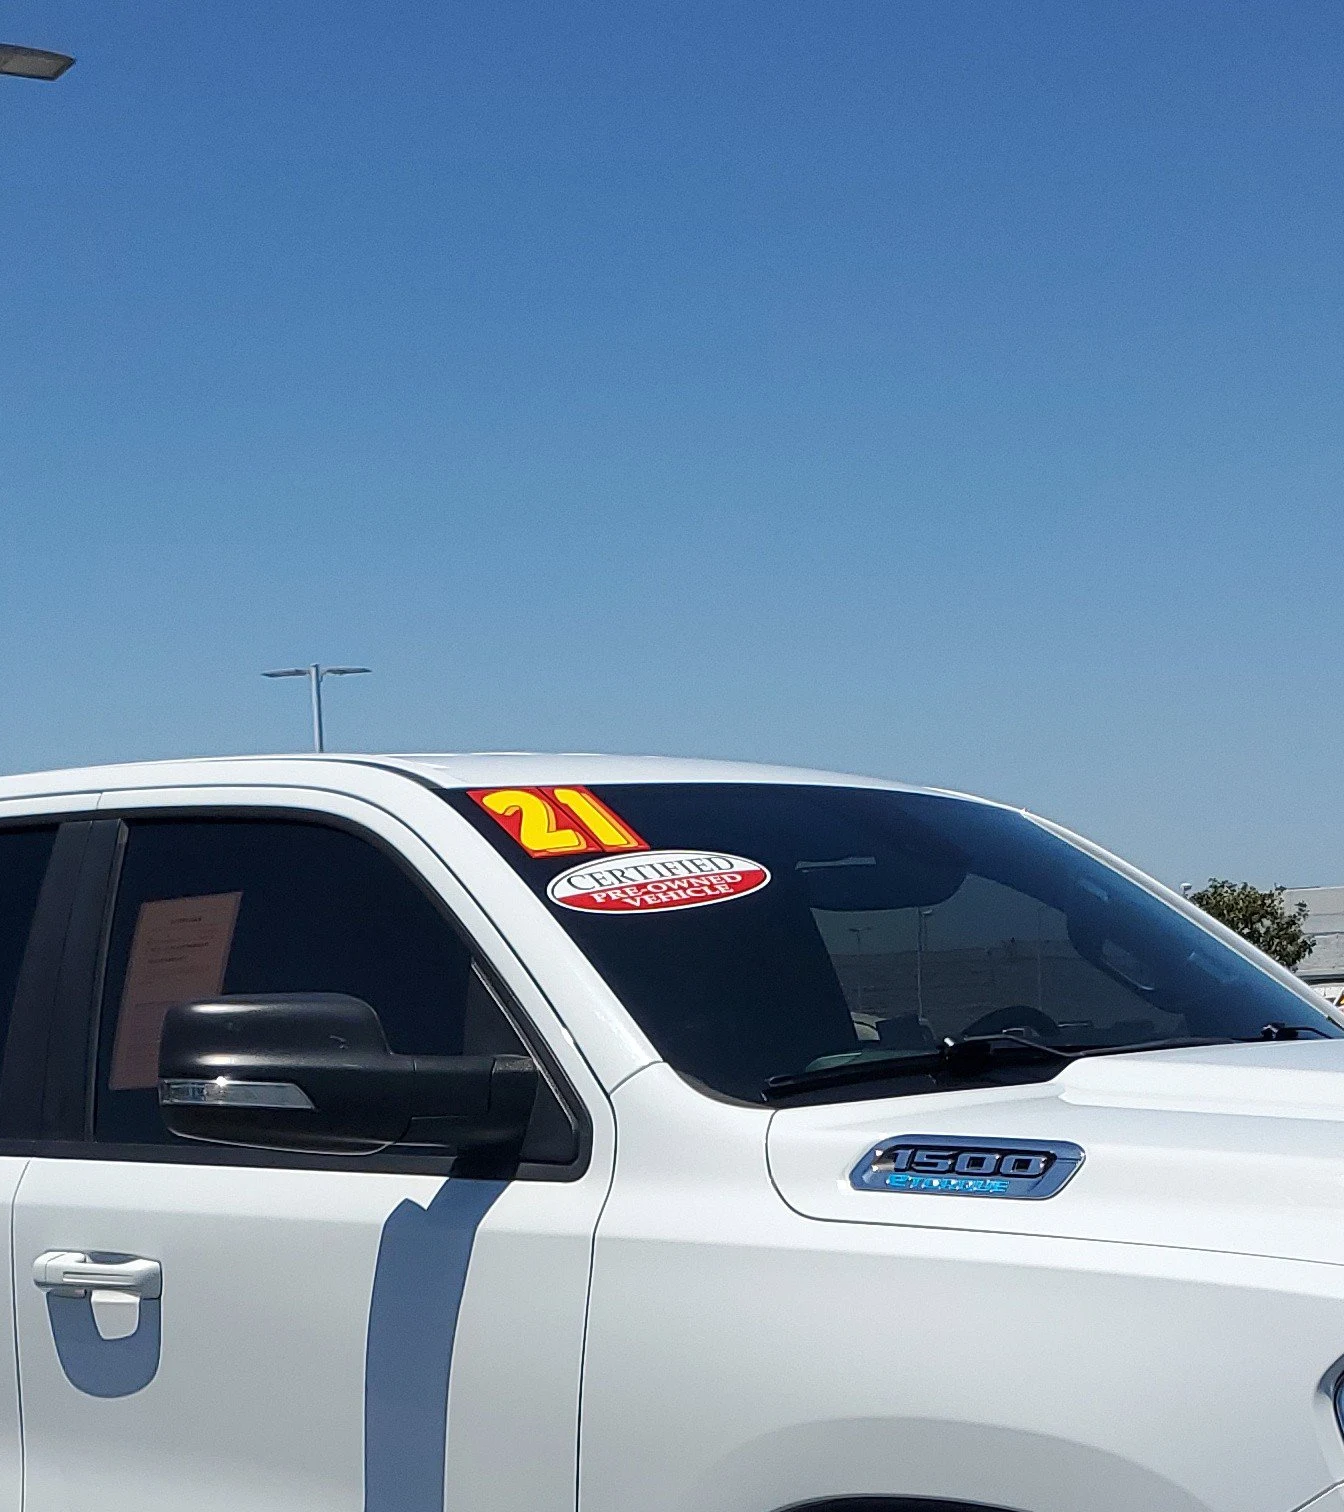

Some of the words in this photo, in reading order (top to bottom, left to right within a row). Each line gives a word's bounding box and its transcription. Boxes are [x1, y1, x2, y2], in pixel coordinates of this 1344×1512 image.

[482, 788, 639, 851] 21
[565, 855, 734, 891] CERTIFIED
[590, 871, 743, 904] PRE-OWNED
[622, 883, 734, 908] VEHICLE
[890, 1149, 1048, 1177] 1500
